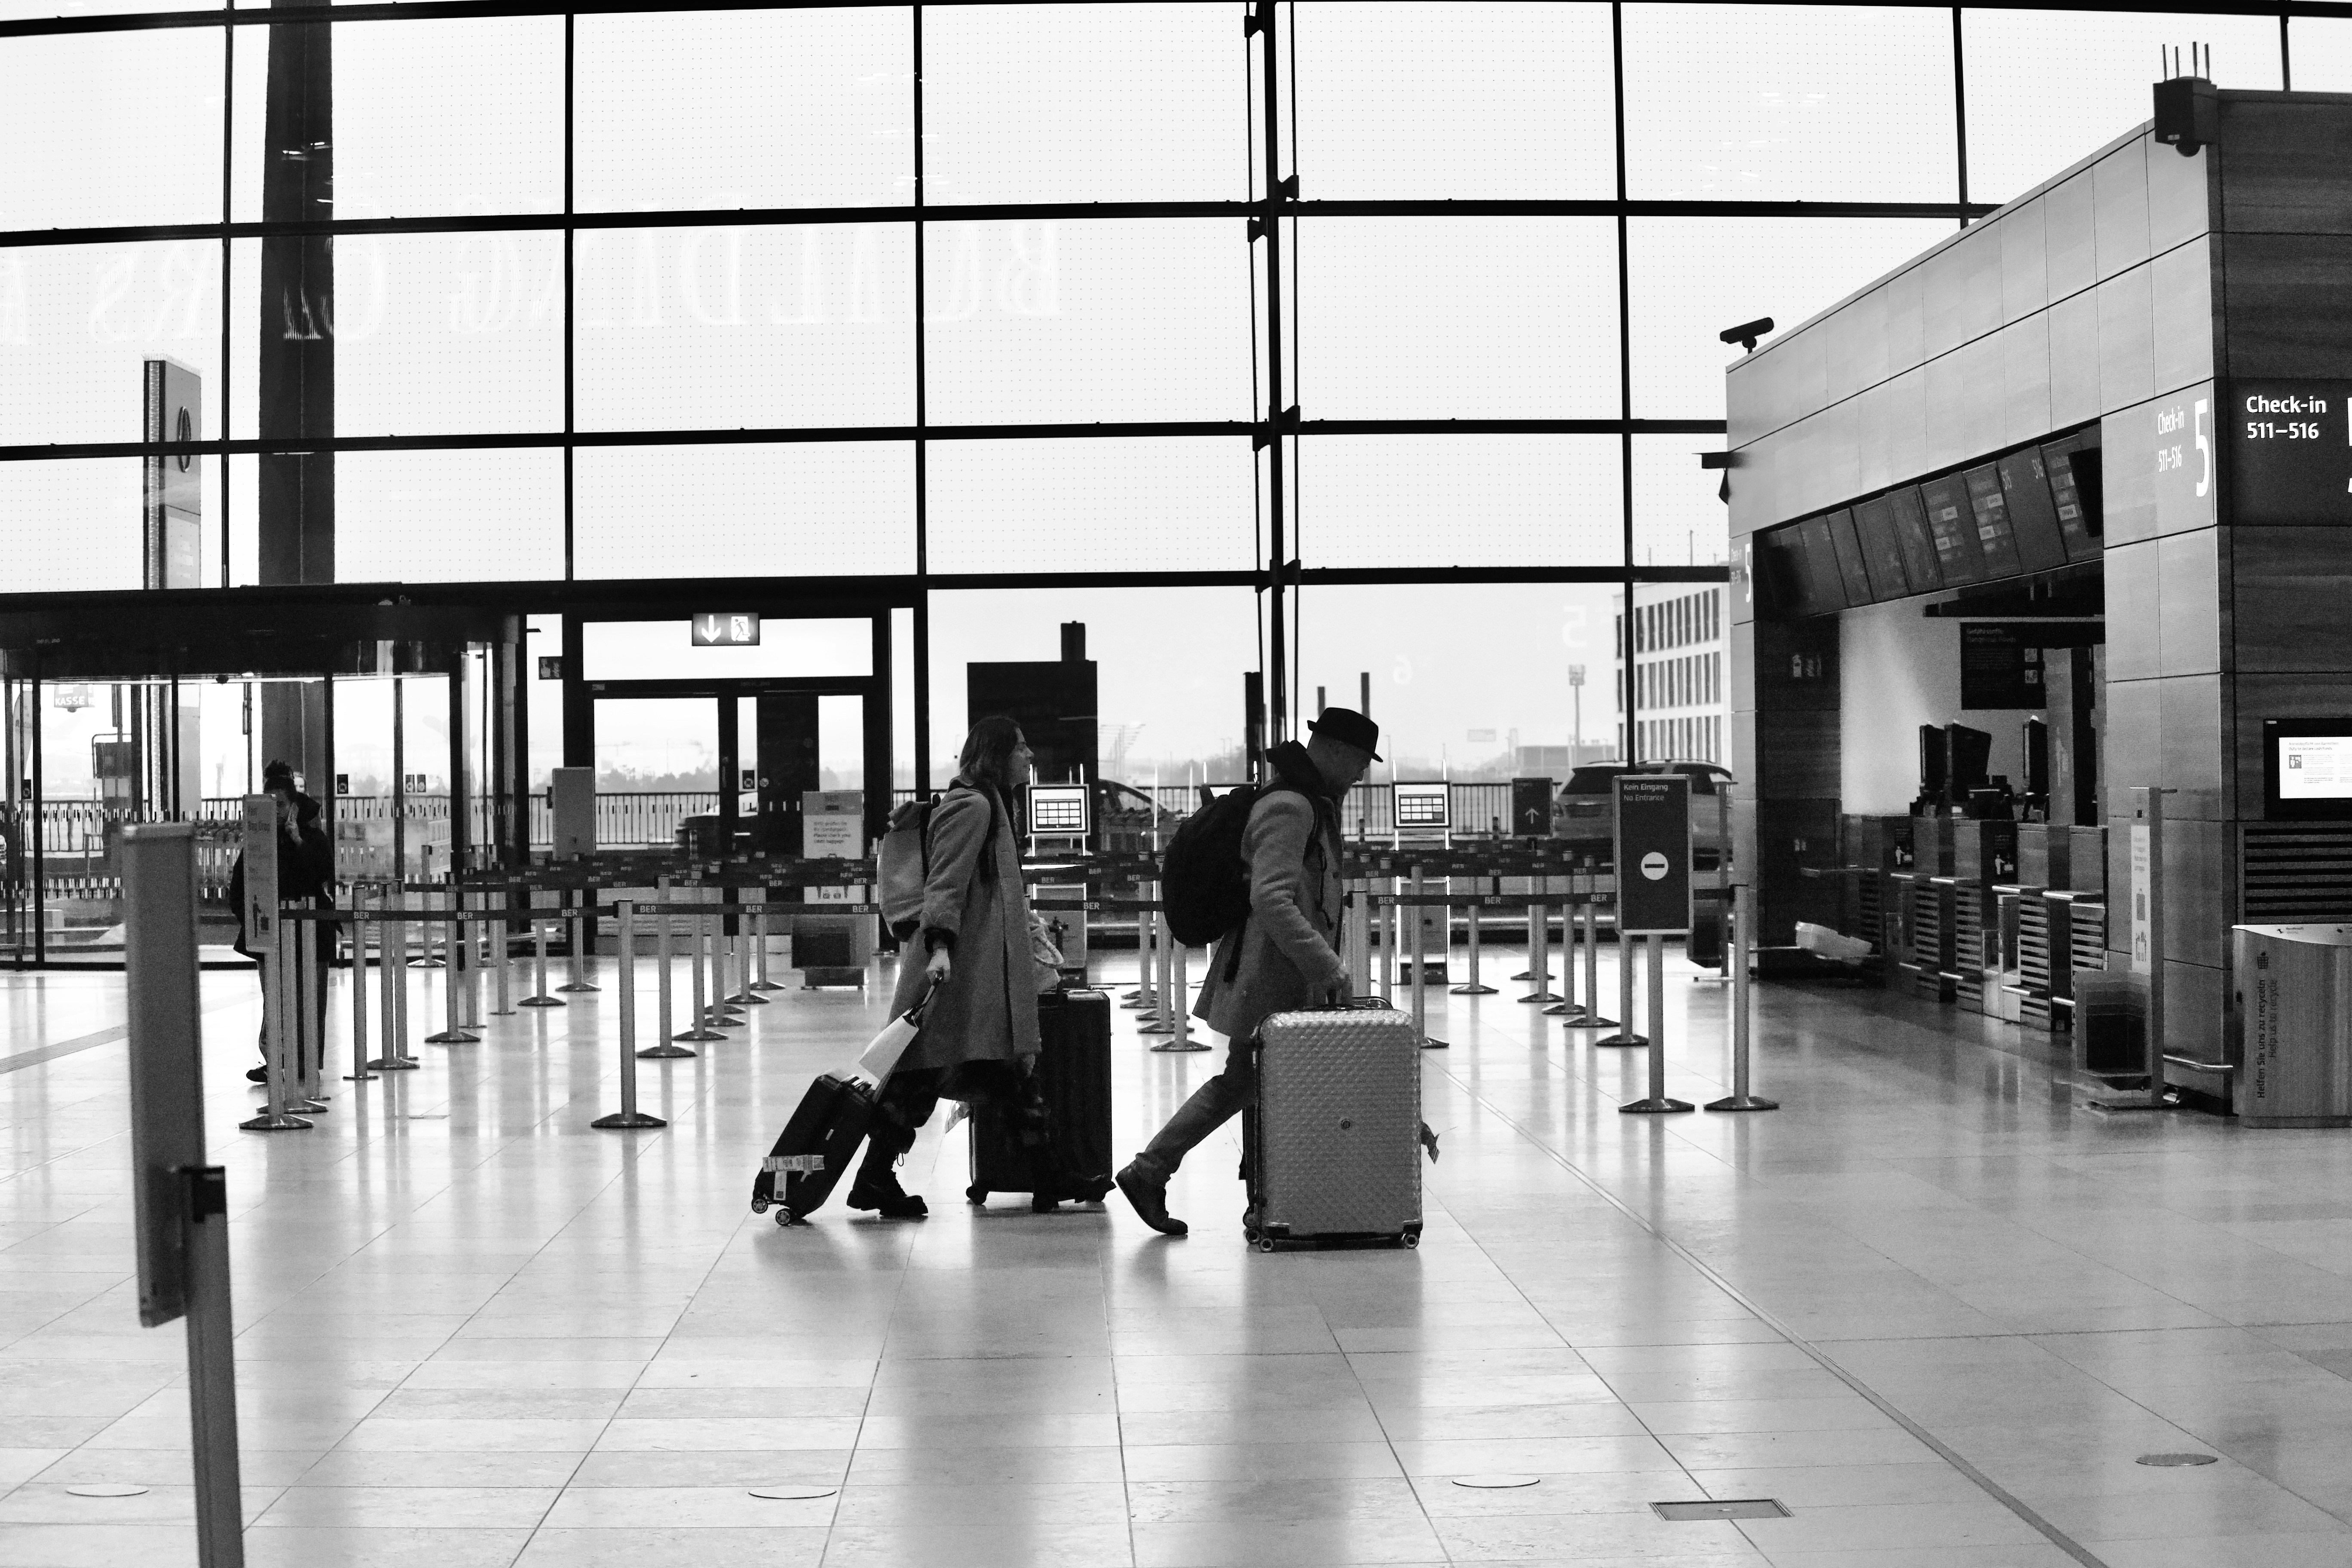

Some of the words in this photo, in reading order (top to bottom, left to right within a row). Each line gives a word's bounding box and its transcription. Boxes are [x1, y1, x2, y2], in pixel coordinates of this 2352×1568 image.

[2246, 395, 2326, 413] Check-in
[2158, 405, 2185, 435] Check-in
[2194, 398, 2210, 497] 5
[1745, 543, 1752, 603] 5
[55, 696, 85, 705] KASSE
[1641, 784, 1668, 792] Eingang
[1083, 902, 1100, 910] BER
[1591, 894, 1607, 902] BER
[2257, 979, 2267, 1017] recyceln
[2268, 979, 2279, 1011] recycle
[2258, 1020, 2265, 1031] zu
[2269, 1013, 2277, 1023] to
[2269, 1026, 2277, 1035] us
[2268, 1038, 2278, 1058] Help
[2257, 1052, 2265, 1066] Sie
[2256, 1069, 2266, 1099] Helfen
